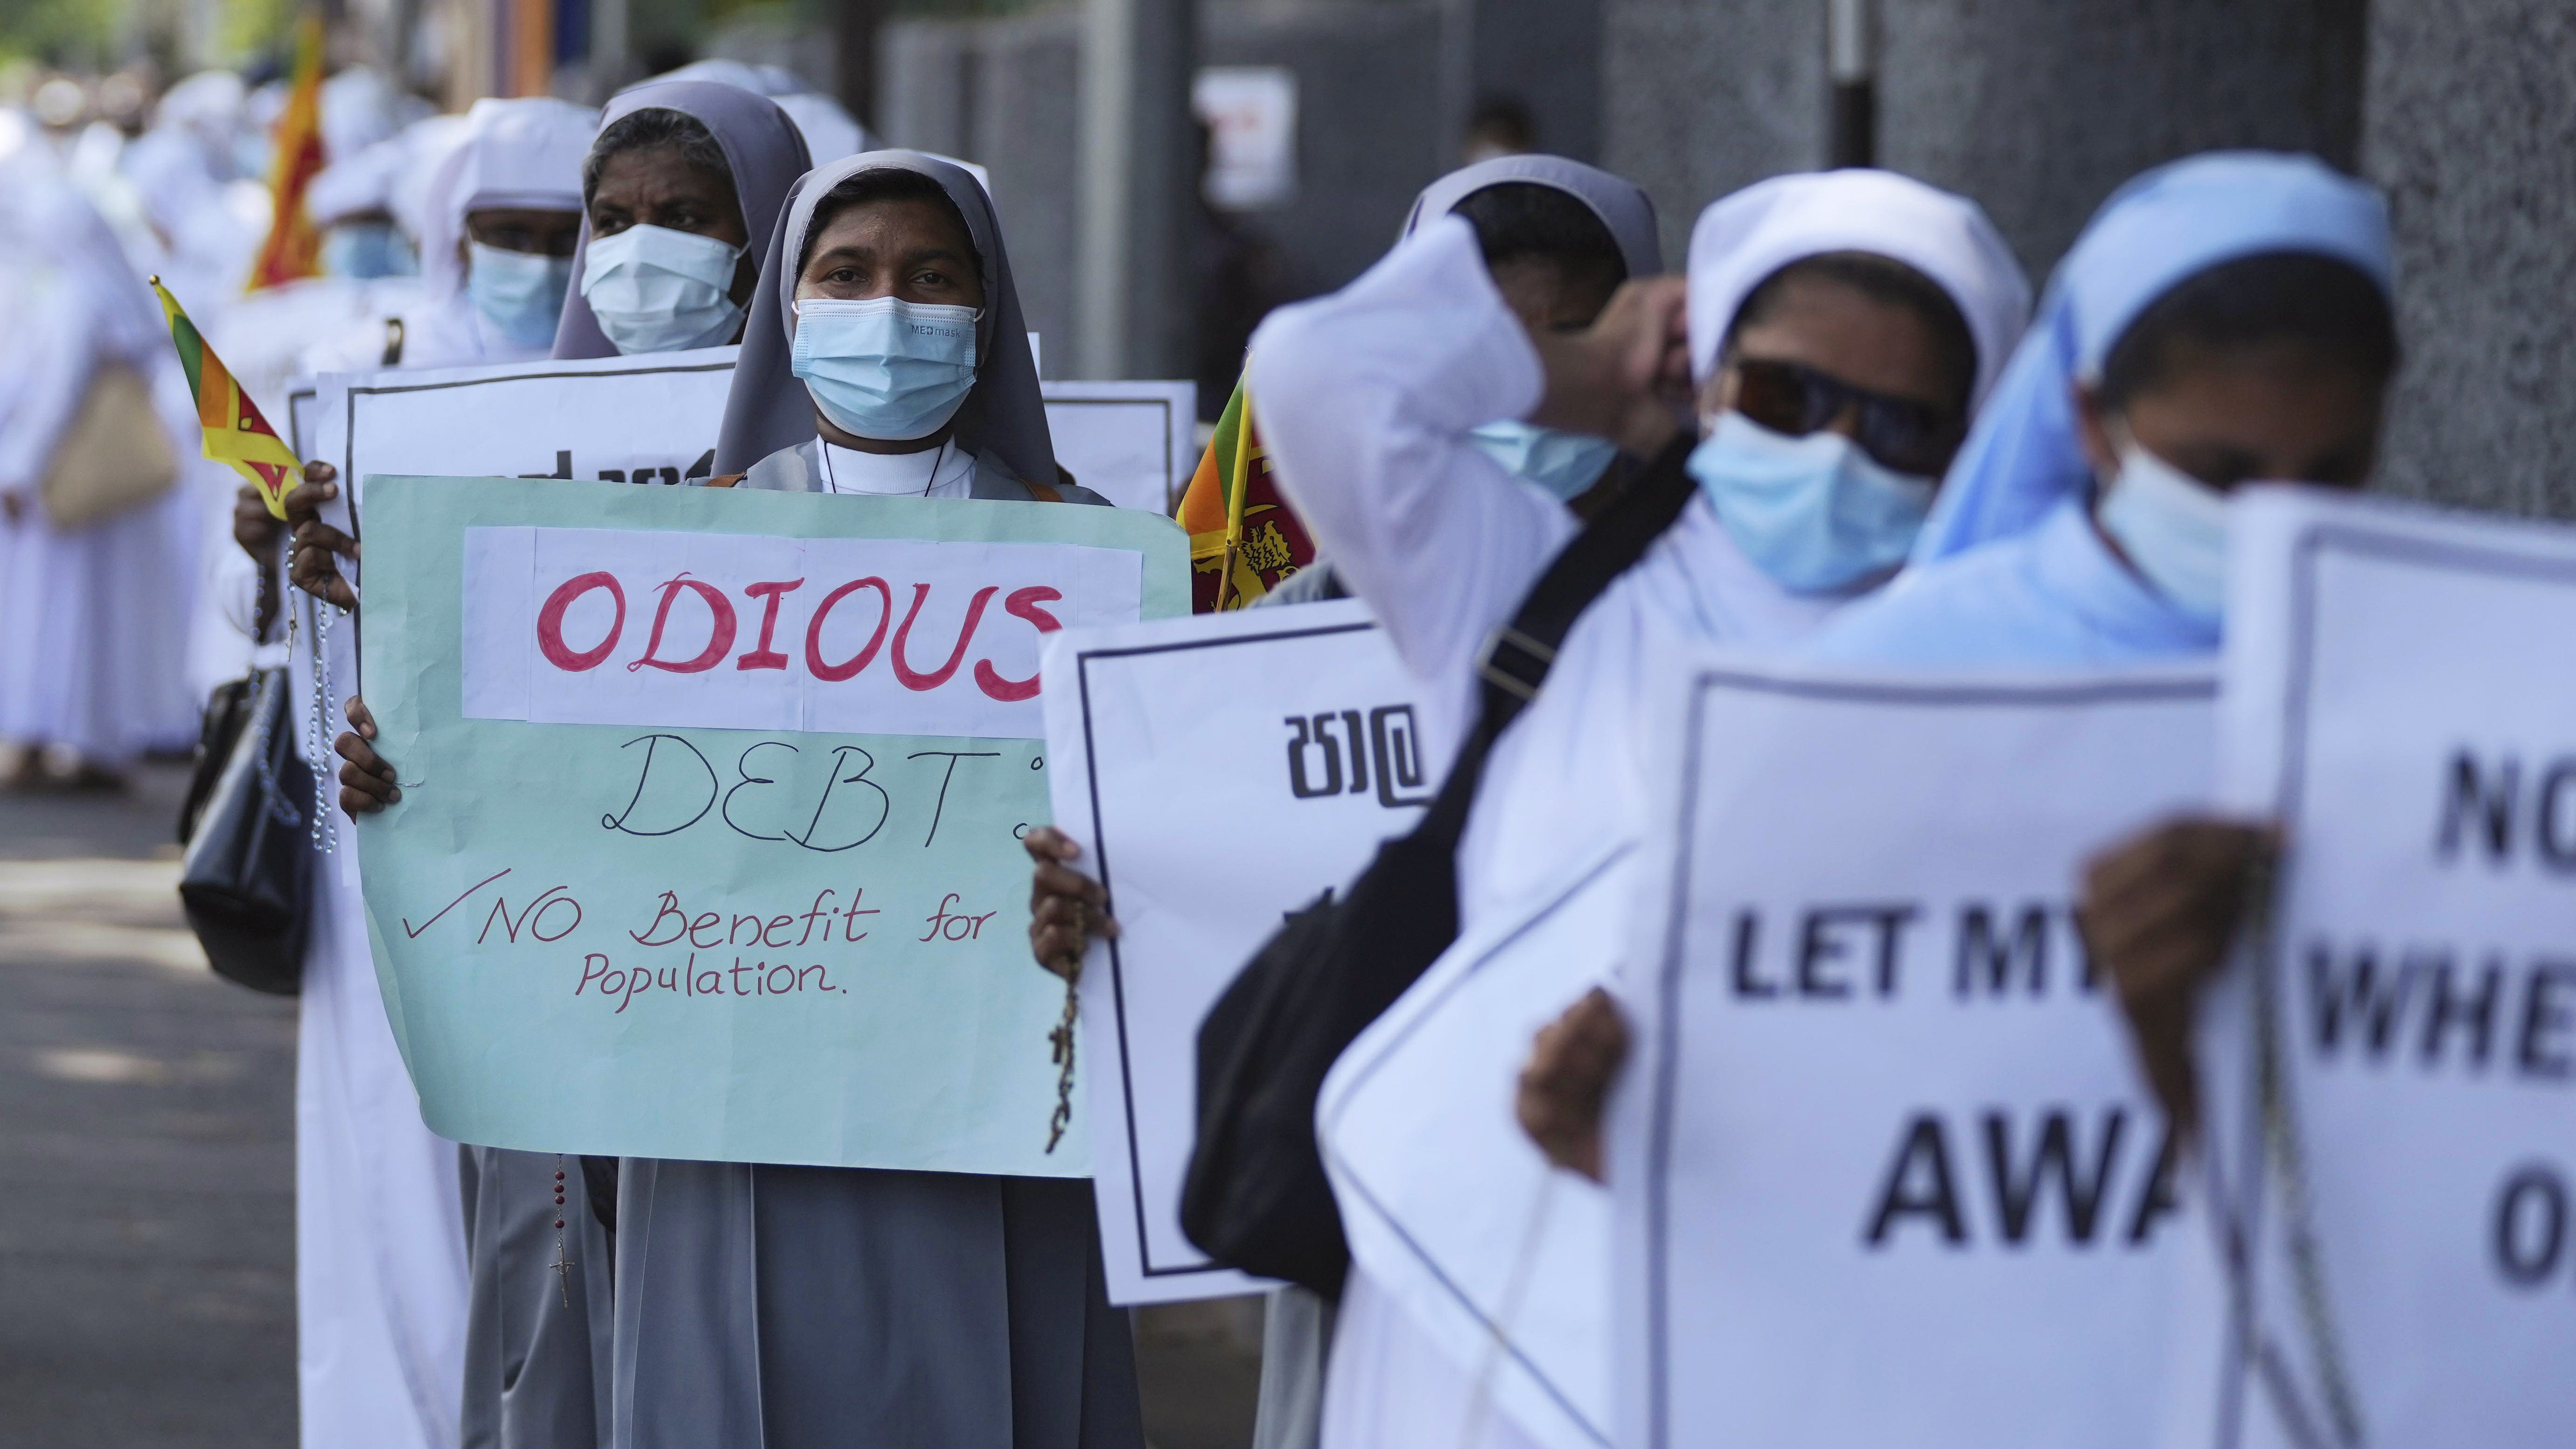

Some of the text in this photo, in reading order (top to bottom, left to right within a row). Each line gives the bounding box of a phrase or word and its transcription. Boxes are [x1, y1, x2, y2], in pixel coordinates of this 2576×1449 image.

[537, 571, 1062, 702] ODIOUS
[478, 885, 997, 947] NO Benefit for
[1729, 901, 1923, 999] LET
[575, 952, 847, 1014] Population.
[2491, 1164, 2576, 1290] O
